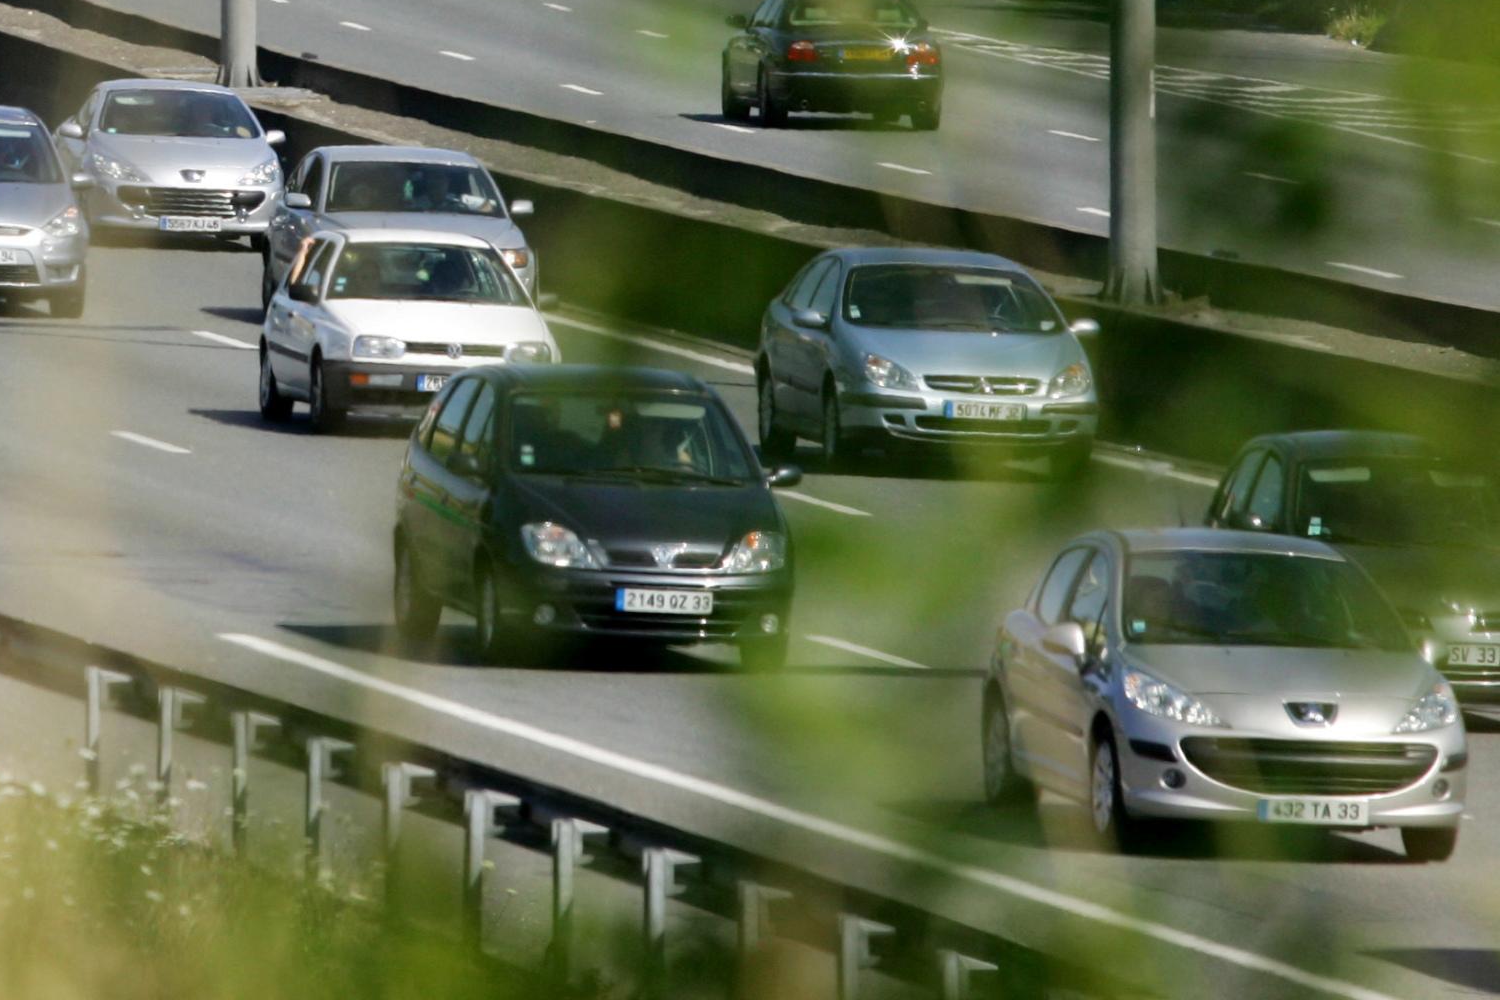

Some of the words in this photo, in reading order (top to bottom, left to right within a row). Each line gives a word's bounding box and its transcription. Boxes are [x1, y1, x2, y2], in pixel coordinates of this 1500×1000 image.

[957, 404, 985, 417] 5074
[627, 592, 665, 608] 2149
[669, 594, 688, 610] QZ
[692, 595, 711, 611] 33
[1451, 647, 1470, 662] SV
[1477, 647, 1496, 664] 33
[1273, 801, 1305, 818] 432
[1311, 802, 1331, 820] TA
[1338, 803, 1360, 820] 33
